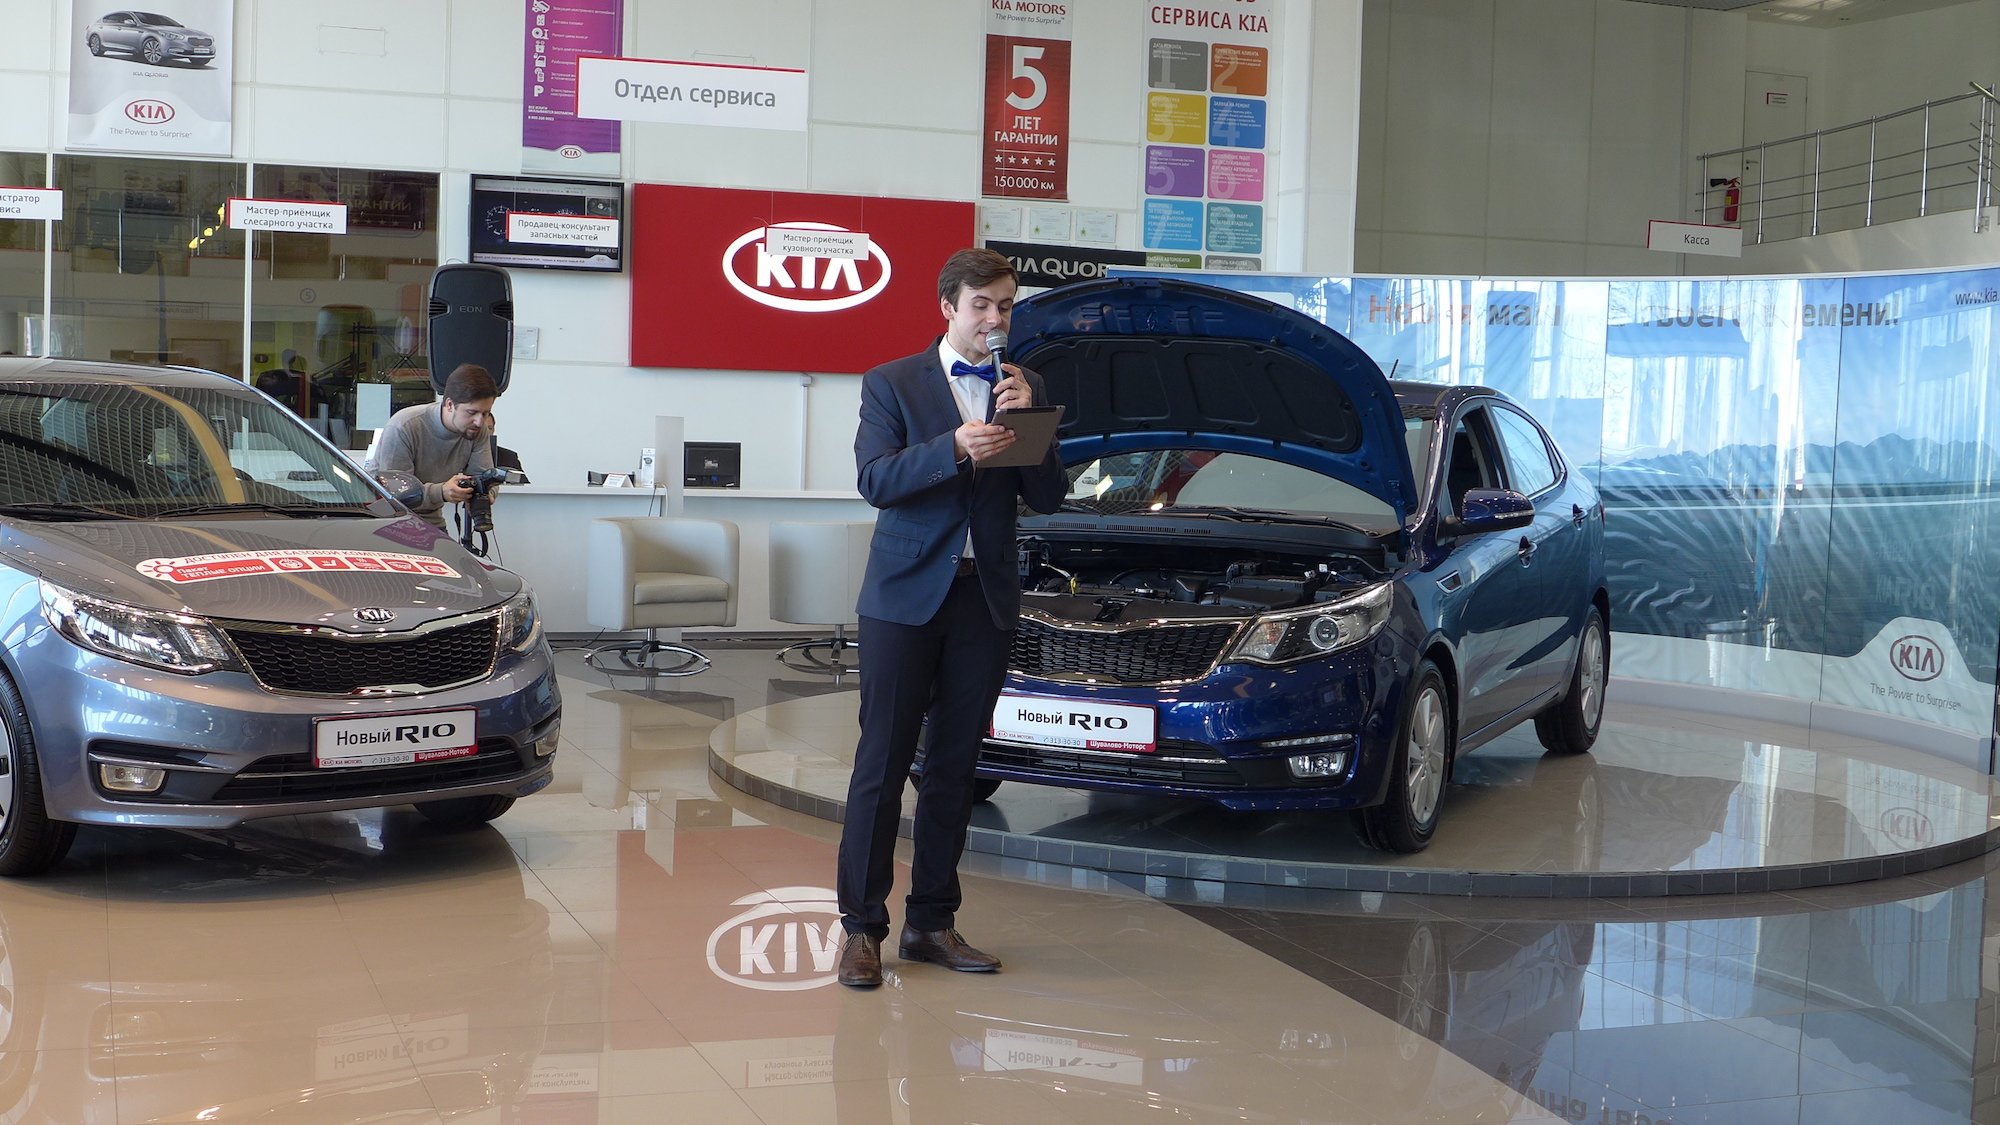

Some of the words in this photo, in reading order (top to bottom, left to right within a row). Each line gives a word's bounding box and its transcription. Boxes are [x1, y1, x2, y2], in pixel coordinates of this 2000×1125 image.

[991, 0, 1011, 11] KIA
[1015, 2, 1066, 15] MOTORS
[1151, 6, 1232, 30] СЕРВИСА
[1239, 14, 1268, 33] KIA
[1005, 45, 1048, 110] 5
[615, 78, 682, 103] Отдел
[689, 86, 776, 108] сервиса
[133, 104, 167, 119] KIA
[1012, 115, 1041, 130] ЛЕТ
[110, 127, 123, 135] The
[124, 128, 148, 136] Power
[994, 131, 1058, 146] ГАРАНТИИ
[994, 175, 1014, 188] 150
[1016, 177, 1039, 189] 000
[246, 205, 331, 218] Мастер-приёмщик
[349, 200, 412, 211] АРАНТИИ
[243, 218, 295, 230] слесарного
[297, 219, 334, 231] участка
[518, 219, 611, 232] Продавец-консультант
[530, 231, 568, 240] запасных
[570, 233, 598, 241] частей
[783, 233, 854, 245] Мастер-приёмщик
[1684, 233, 1710, 246] Касса
[782, 244, 822, 254] кузовного
[823, 246, 854, 255] участка
[755, 242, 863, 291] KIA
[459, 305, 483, 313] EON
[1764, 293, 1899, 329] емени!
[184, 552, 252, 564] ДОСТУПЕН
[341, 550, 439, 562] КОМПЛЕКТАЦИИ
[176, 566, 209, 574] Пакет
[181, 569, 227, 579] ТЕПЛЫЕ
[228, 565, 266, 574] ОПЦИИ
[361, 608, 391, 621] KIA
[1899, 643, 1936, 673] KIA
[1870, 682, 1886, 696] The
[1888, 686, 1913, 701] Power
[1915, 691, 1925, 704] to
[1017, 708, 1063, 725] Новый
[1069, 712, 1128, 731] RIO
[336, 727, 391, 747] Новый
[395, 723, 456, 744] RIO
